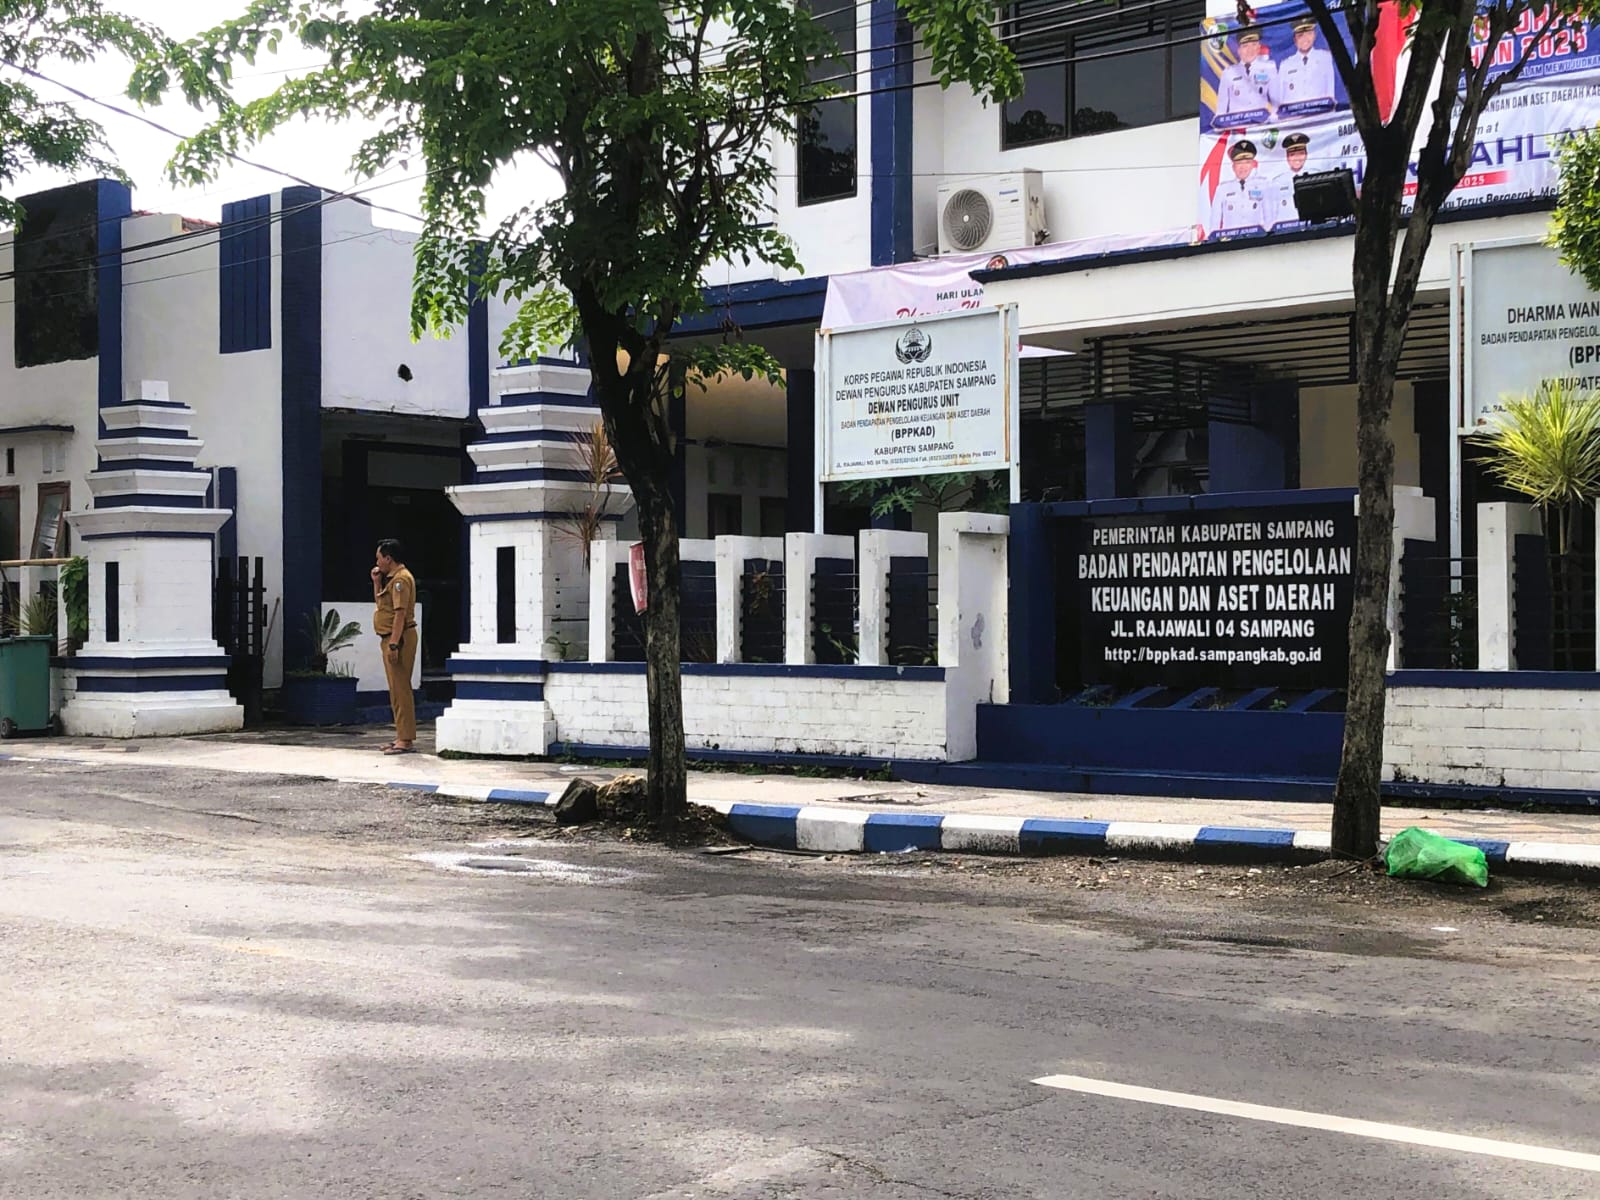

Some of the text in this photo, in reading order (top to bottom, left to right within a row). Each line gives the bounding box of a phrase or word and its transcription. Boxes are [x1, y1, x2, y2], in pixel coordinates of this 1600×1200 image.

[1544, 55, 1600, 74] MEWUJUDKA
[1512, 95, 1529, 109] DAN
[1530, 91, 1549, 105] ASET
[1551, 87, 1584, 102] DAERAH
[936, 289, 958, 302] HARI
[1507, 303, 1566, 324] DHARMA
[1481, 325, 1600, 345] BADAN PENDAPATAN PENGELOL
[844, 360, 988, 386] KORPS PEGAWAI REPUBLIK INDONESIA
[835, 373, 997, 402] DEWAN PENGURUS KABUPATEN SAMPANG
[868, 393, 960, 415] DEWAN PENGURUS UNIT
[946, 410, 957, 420] DAN
[957, 409, 970, 419] ASET
[970, 407, 991, 418] DAERAH
[891, 425, 936, 442] (BPPKAD)
[874, 441, 955, 457] KABUPATEN SAMPANG
[1093, 519, 1335, 546] PEMERINTAH KABUPATEN SAMPANG
[1078, 546, 1351, 580] BADAN PENDAPATAN PENGELOLAAN
[1091, 582, 1335, 613] KEUANGAN DAN ASET DAERAH
[1215, 618, 1235, 638] 04
[1240, 618, 1315, 638] SAMPANG
[1104, 646, 1322, 666] http://bppkad.sampangkab.go.id
